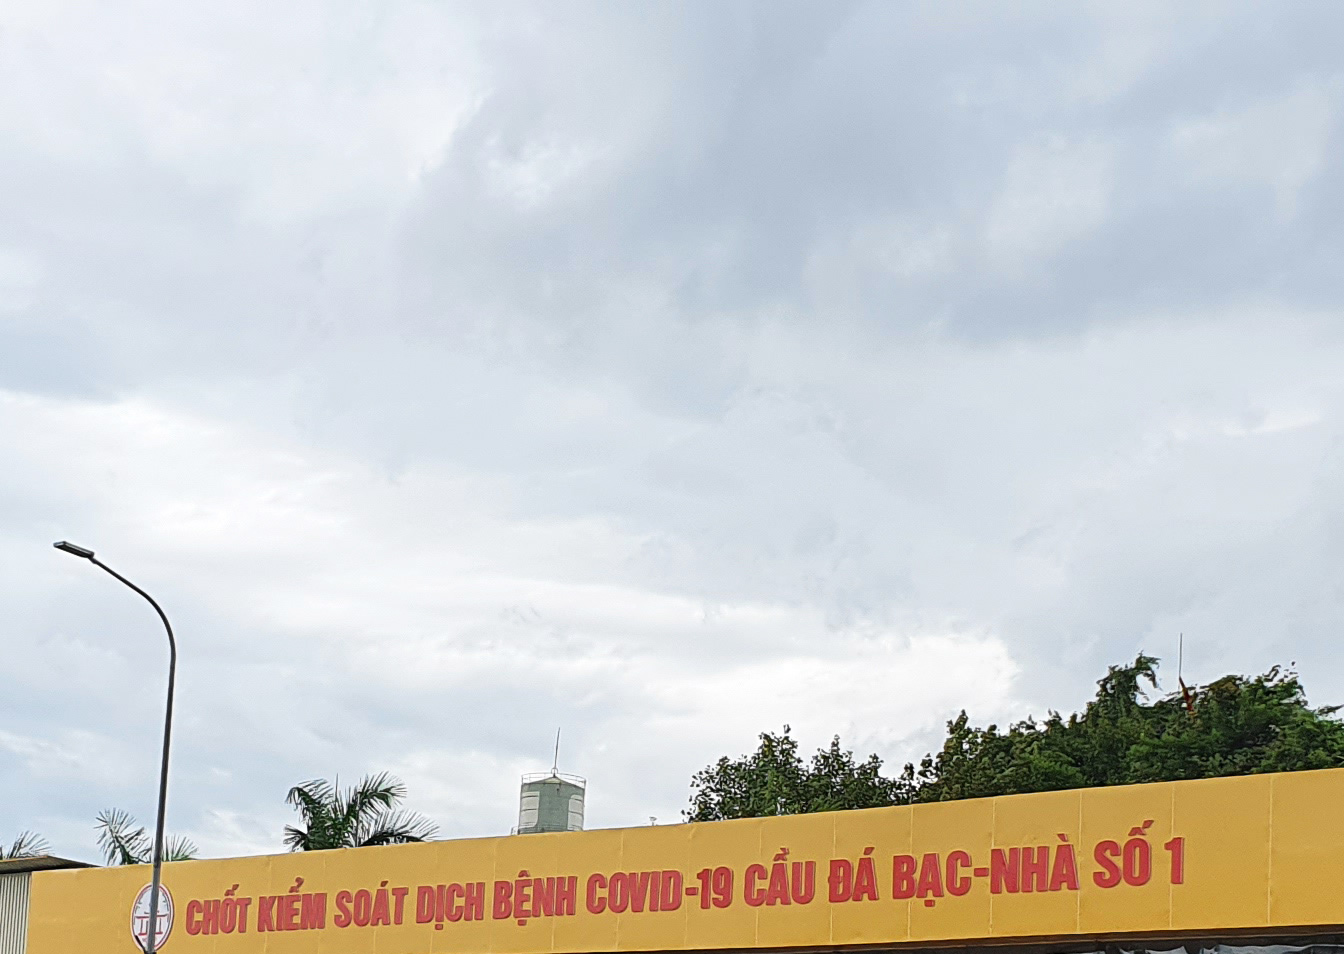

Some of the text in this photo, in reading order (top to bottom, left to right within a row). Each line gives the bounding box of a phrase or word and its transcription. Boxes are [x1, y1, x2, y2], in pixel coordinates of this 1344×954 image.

[185, 819, 1185, 936] CHỐT KIỂM SOÁT DỊCH BỆNH COVID-19 CẦU ĐÁ BẠC-NHÀ SỐ 1
